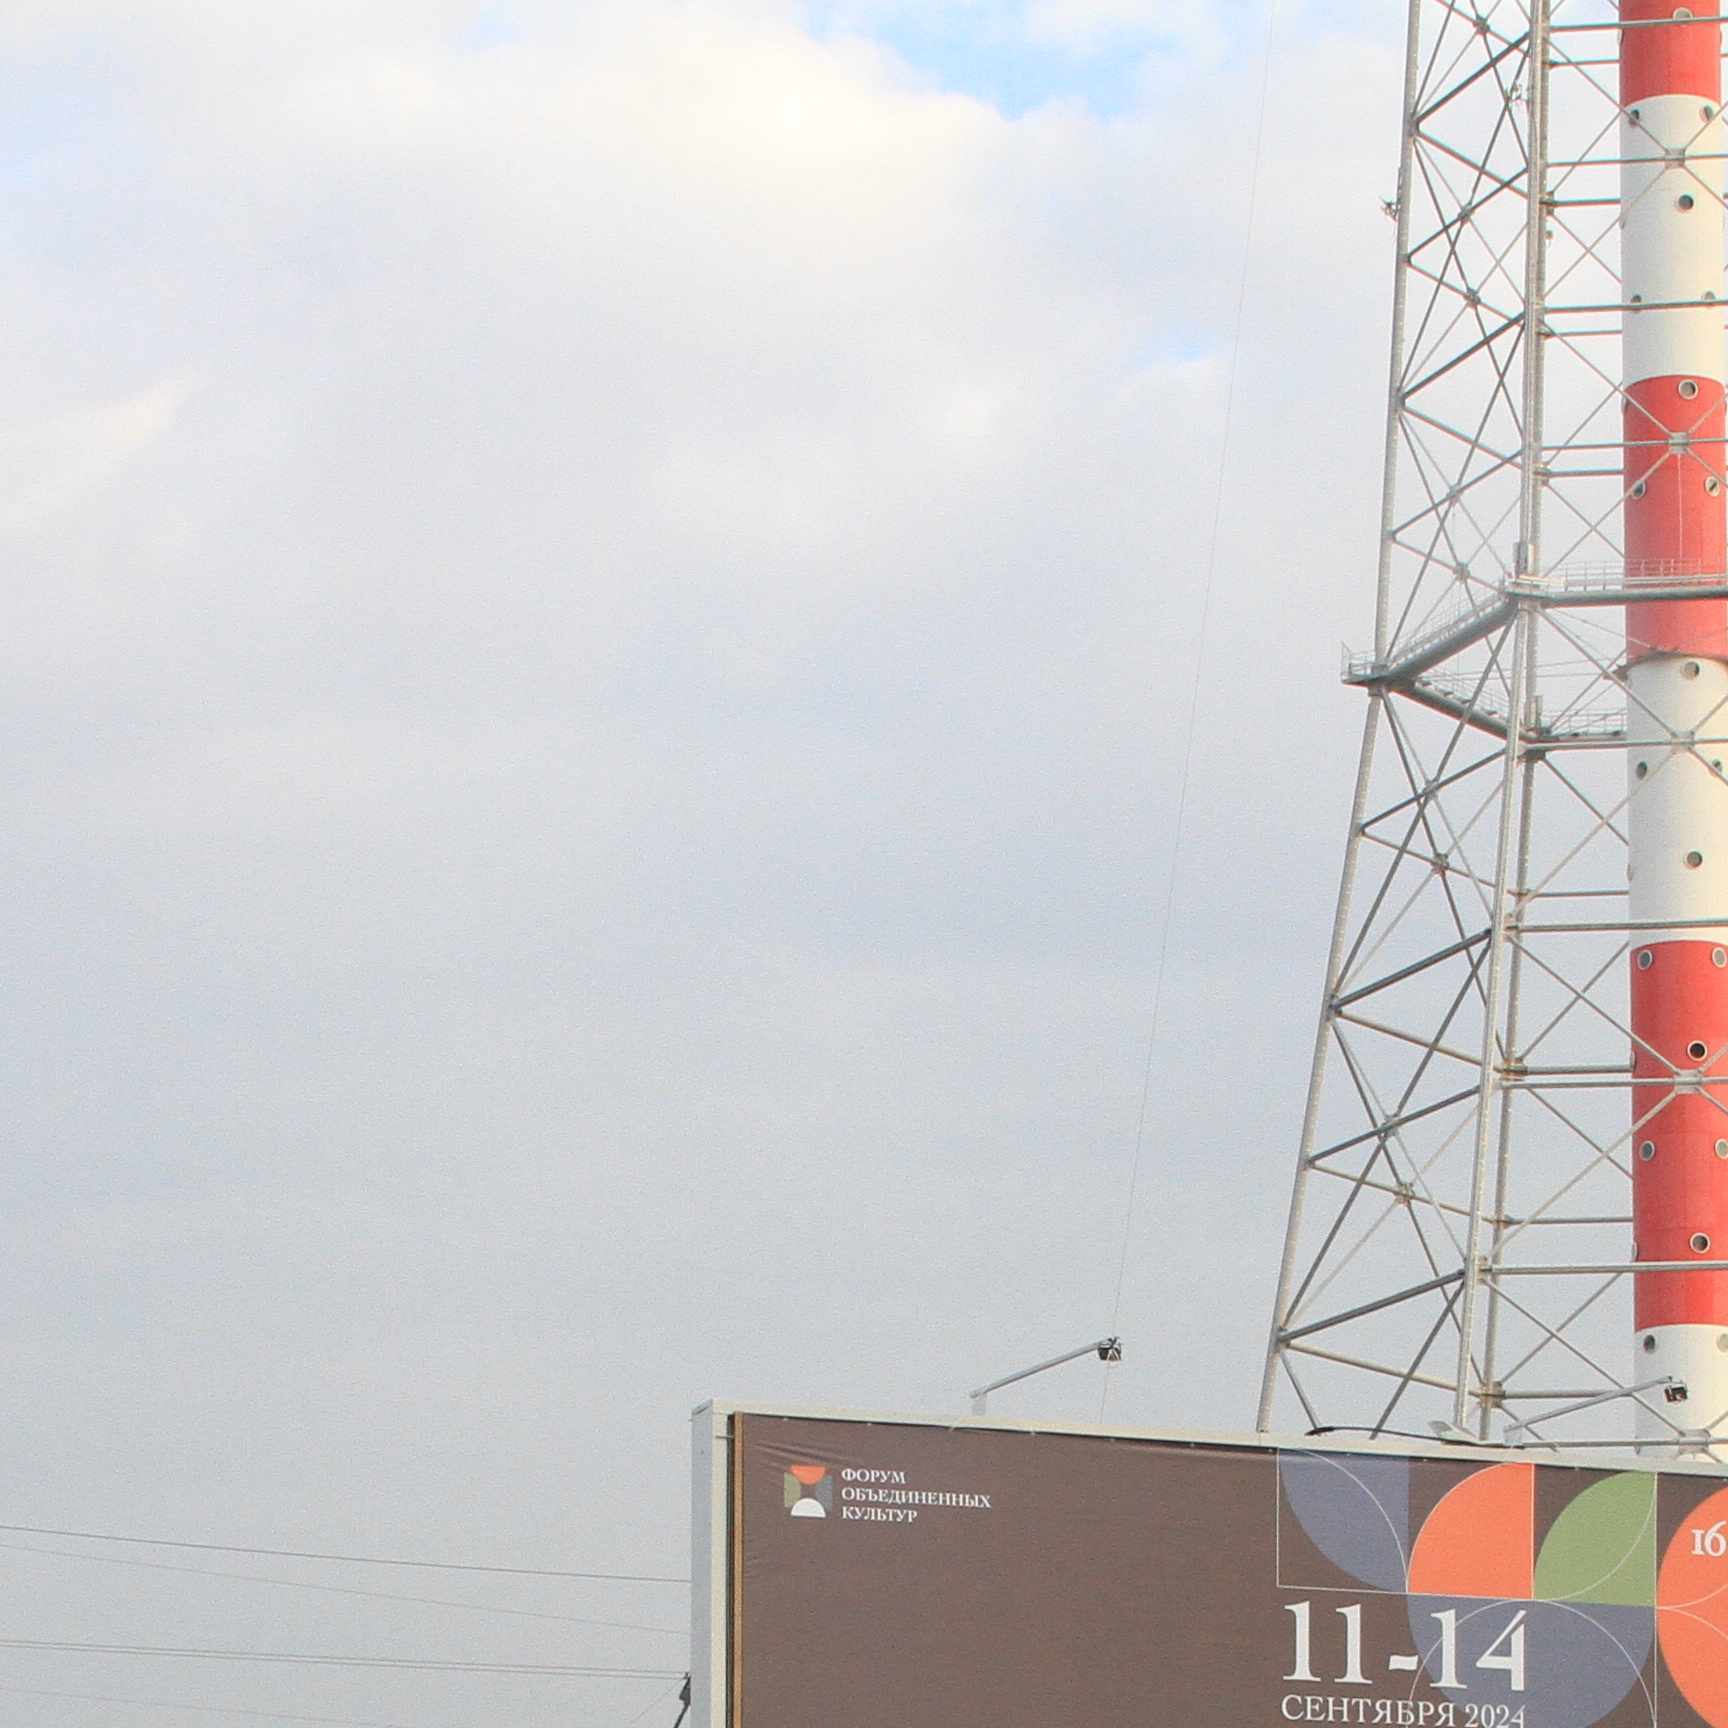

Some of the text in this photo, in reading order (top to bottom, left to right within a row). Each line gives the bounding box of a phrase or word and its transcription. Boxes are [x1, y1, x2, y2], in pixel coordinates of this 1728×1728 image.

[841, 1468, 906, 1484] ФОРУМ
[841, 1487, 992, 1509] ОБЪЕДИНЕННЫХ
[841, 1506, 918, 1523] КУЛЬТУР
[1283, 1600, 1528, 1692] 11-14
[1281, 1694, 1456, 1728] СЕНТЯБРЯ
